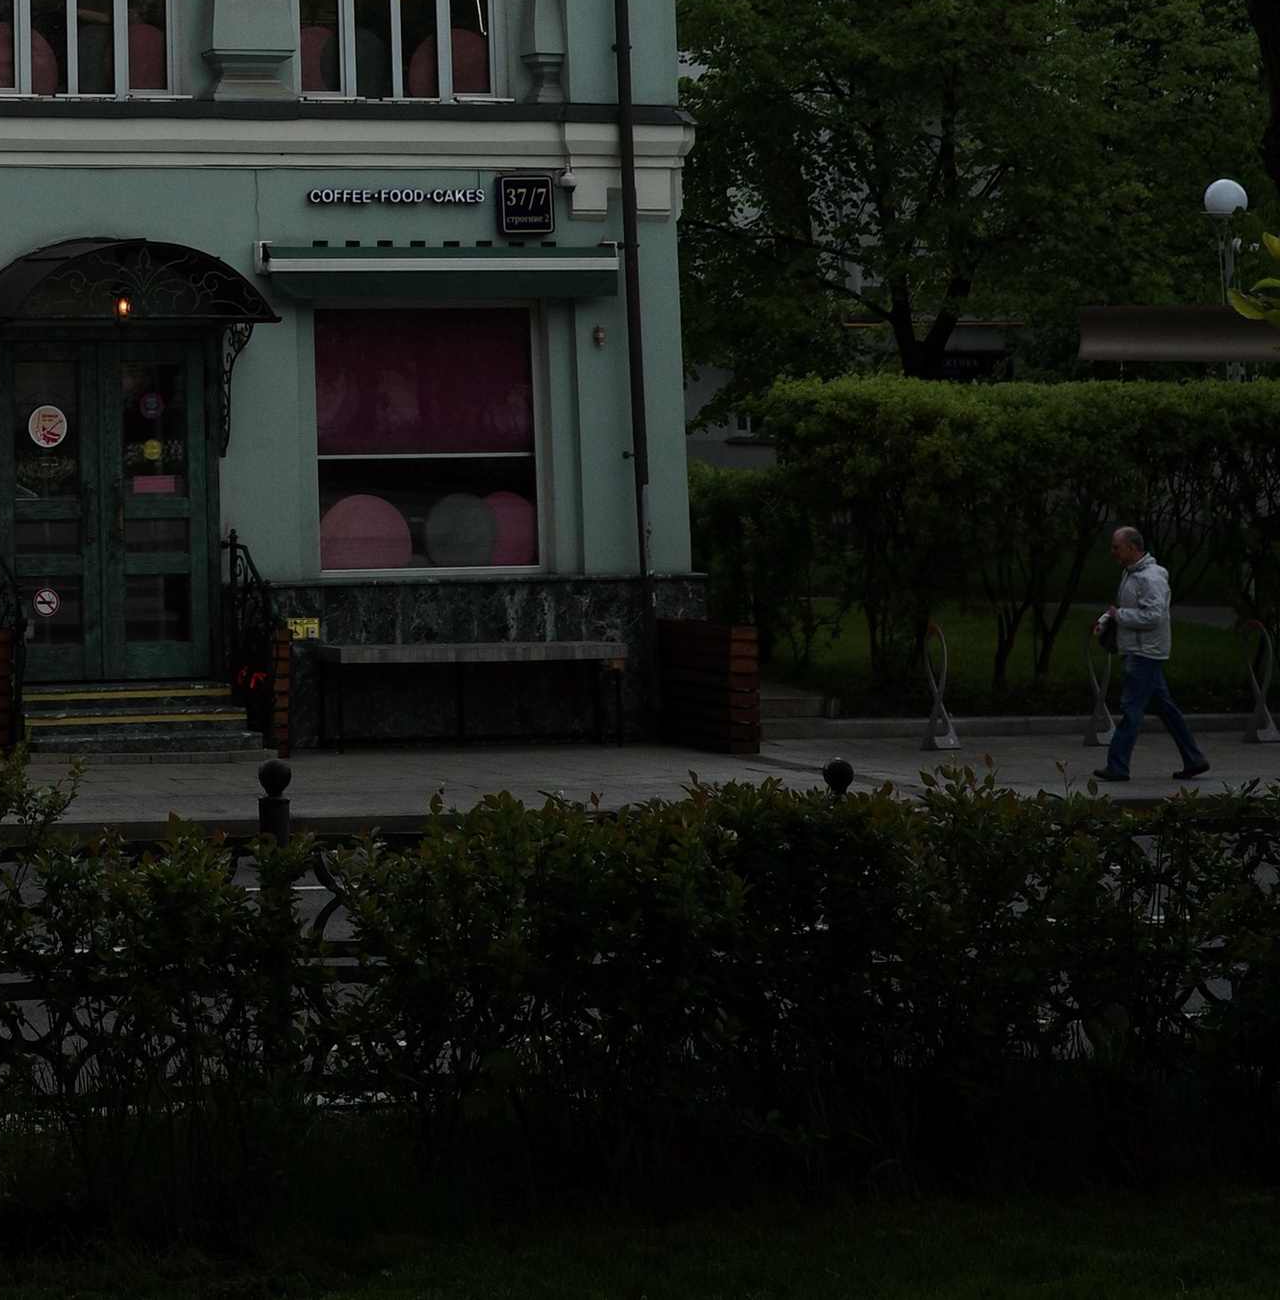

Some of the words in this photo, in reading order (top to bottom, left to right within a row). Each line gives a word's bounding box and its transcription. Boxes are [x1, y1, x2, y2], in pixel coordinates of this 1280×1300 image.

[309, 189, 372, 203] COFFEE
[380, 189, 425, 203] FOOD
[432, 188, 486, 203] CAKES
[506, 187, 548, 211] 37/7
[506, 215, 543, 226] строение
[543, 213, 551, 223] 2
